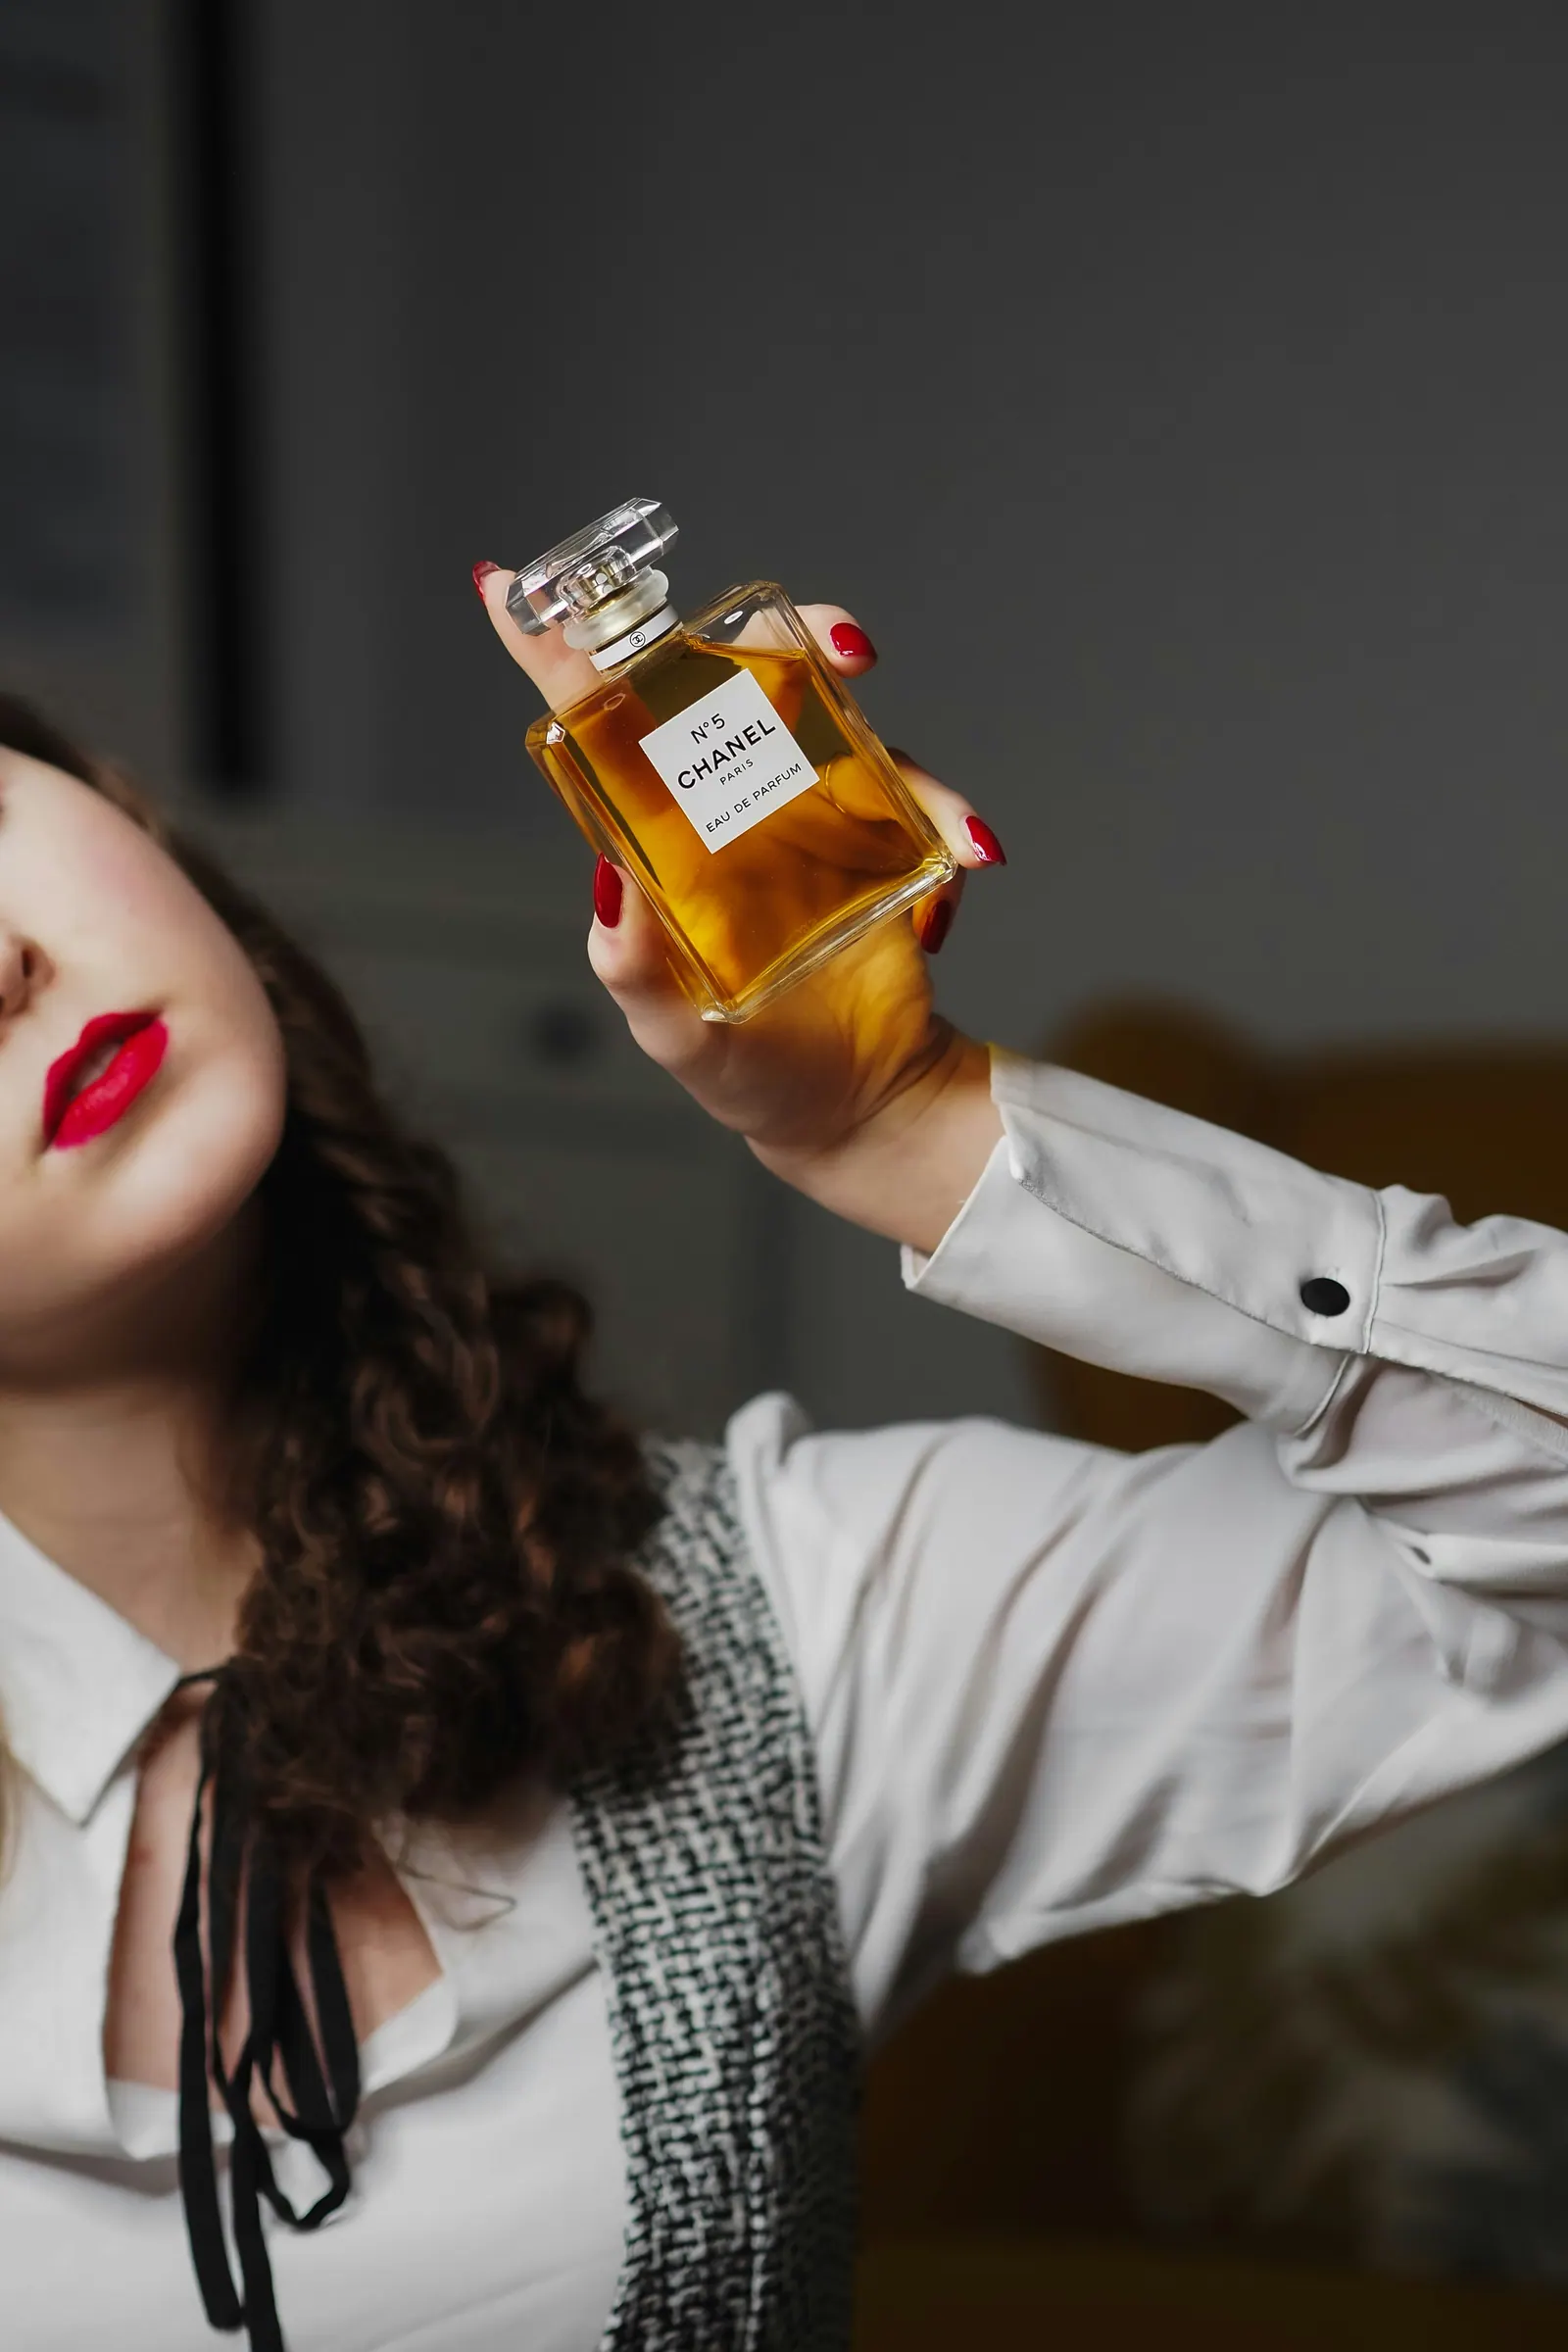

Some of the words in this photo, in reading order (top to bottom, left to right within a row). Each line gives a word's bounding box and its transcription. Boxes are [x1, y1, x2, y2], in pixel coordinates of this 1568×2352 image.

[677, 719, 776, 789] CHANEL
[719, 759, 754, 785] PARIS
[706, 811, 731, 833] EAU
[733, 798, 752, 813] DE
[752, 762, 802, 801] PARFUM
